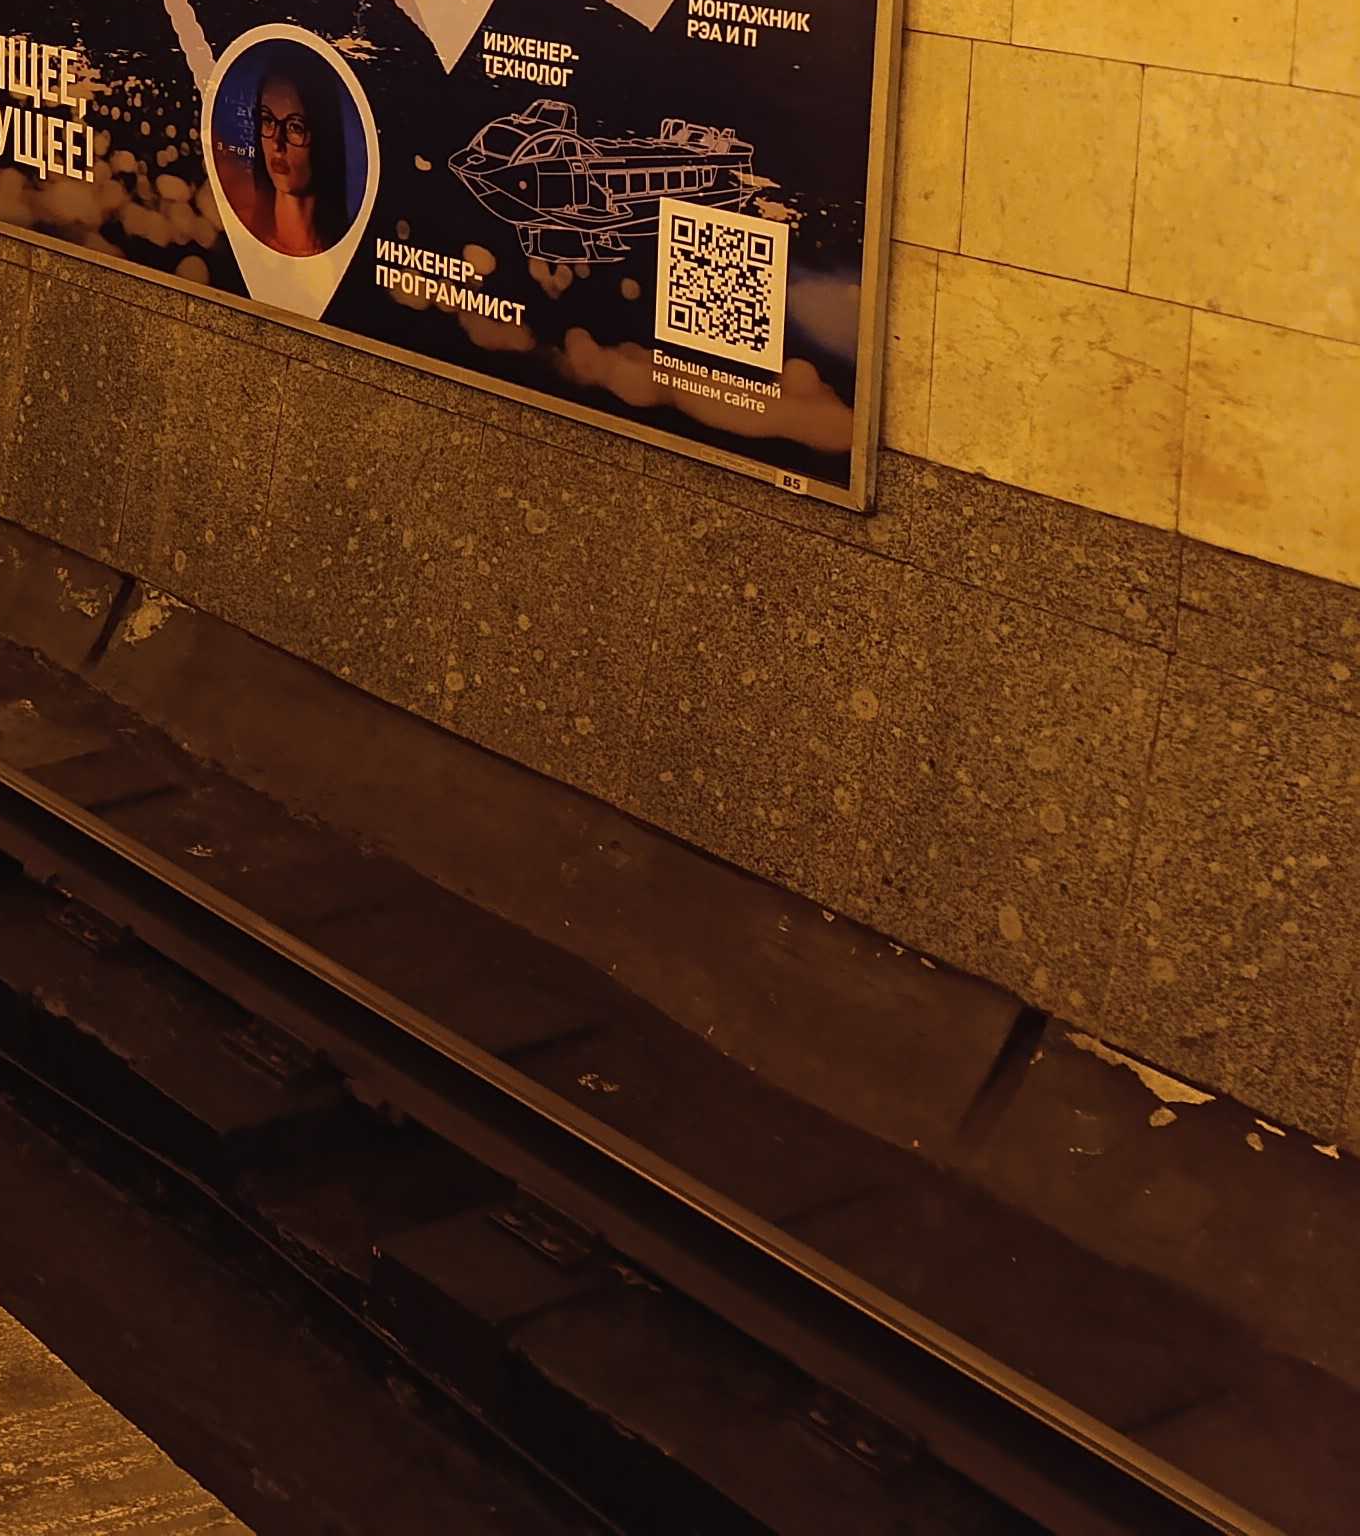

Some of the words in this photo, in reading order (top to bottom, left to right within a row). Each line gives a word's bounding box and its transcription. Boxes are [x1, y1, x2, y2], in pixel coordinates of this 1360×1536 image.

[484, 31, 580, 64] ИНЖЕНЕР-
[687, 20, 722, 42] РЭА
[726, 24, 739, 44] И
[743, 28, 757, 47] П
[482, 54, 573, 87] ТЕХНОЛОГ
[376, 238, 483, 283] ИНЖЕНЕР-
[375, 265, 526, 326] ПРОГРАММИСТ
[652, 370, 669, 385] на
[672, 376, 720, 400] нашем
[724, 391, 765, 414] сайте
[653, 349, 708, 378] Больше
[712, 369, 781, 399] вакансий
